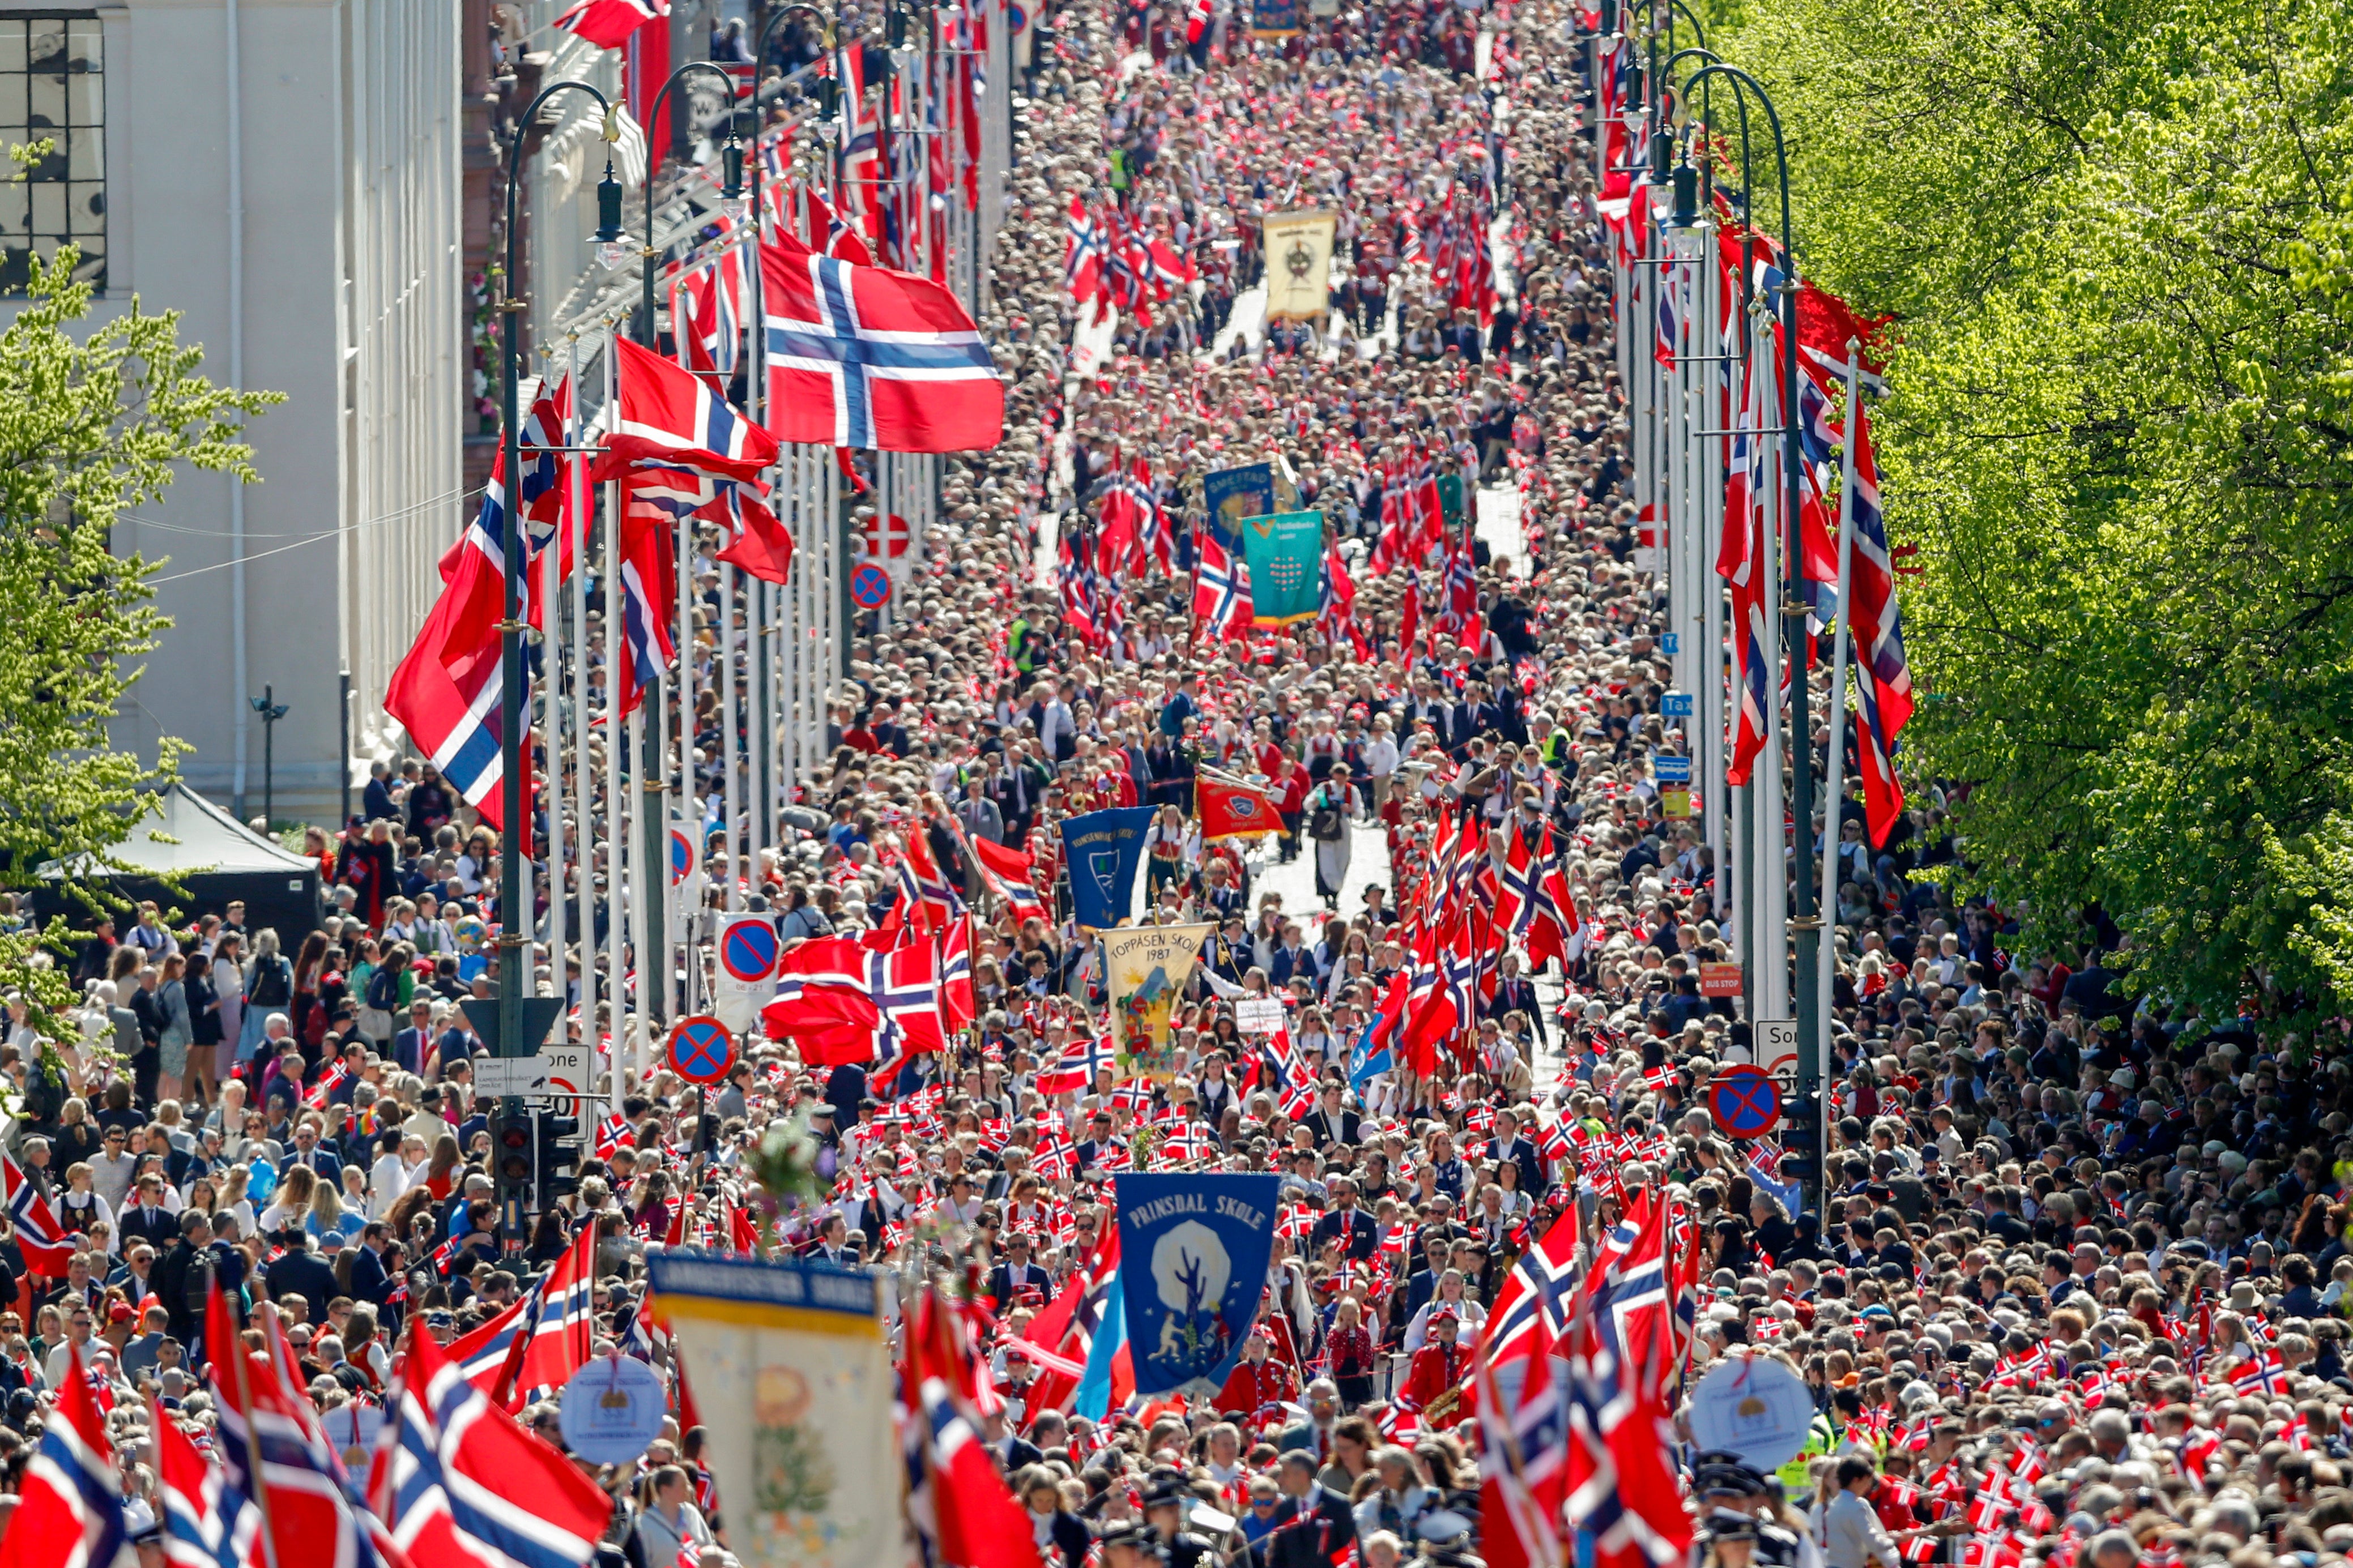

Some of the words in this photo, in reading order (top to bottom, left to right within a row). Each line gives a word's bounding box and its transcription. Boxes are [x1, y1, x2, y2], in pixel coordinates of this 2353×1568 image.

[1111, 934, 1165, 959] TOPPÅSEN
[1146, 949, 1170, 962] 1987
[1706, 980, 1720, 988] BUS
[1720, 980, 1738, 988] STOP
[1770, 1027, 1797, 1044] So
[548, 1054, 578, 1067] one
[1128, 1193, 1208, 1229] PRINSDAL
[1214, 1195, 1267, 1231] SKOLE
